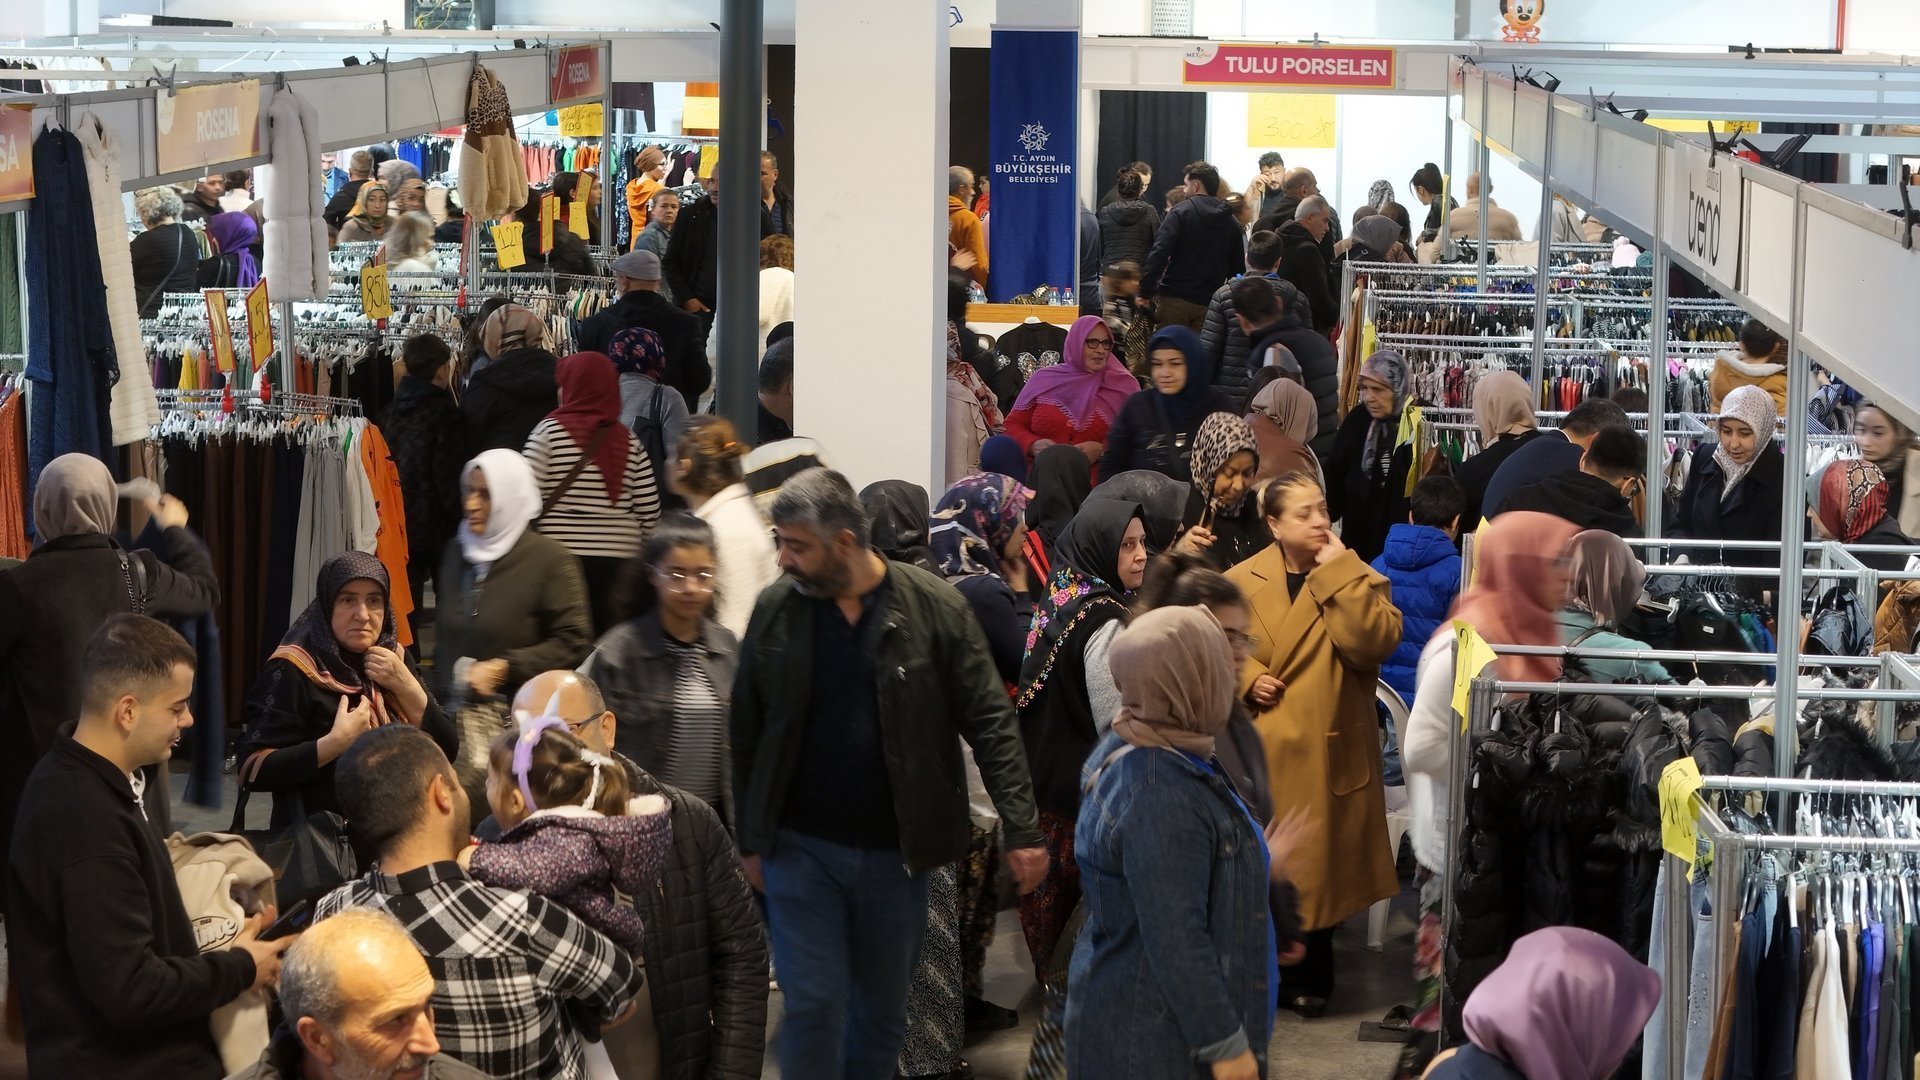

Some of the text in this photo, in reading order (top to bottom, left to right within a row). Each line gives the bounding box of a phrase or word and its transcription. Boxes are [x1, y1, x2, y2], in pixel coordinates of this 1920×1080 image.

[568, 62, 590, 84] ROSENA
[1225, 56, 1387, 76] TULU PORSELEN
[197, 105, 240, 143] ROSENA
[1263, 117, 1304, 139] 300
[995, 163, 1071, 175] BÜYÜKŞEHİR
[1688, 171, 1722, 266] trend
